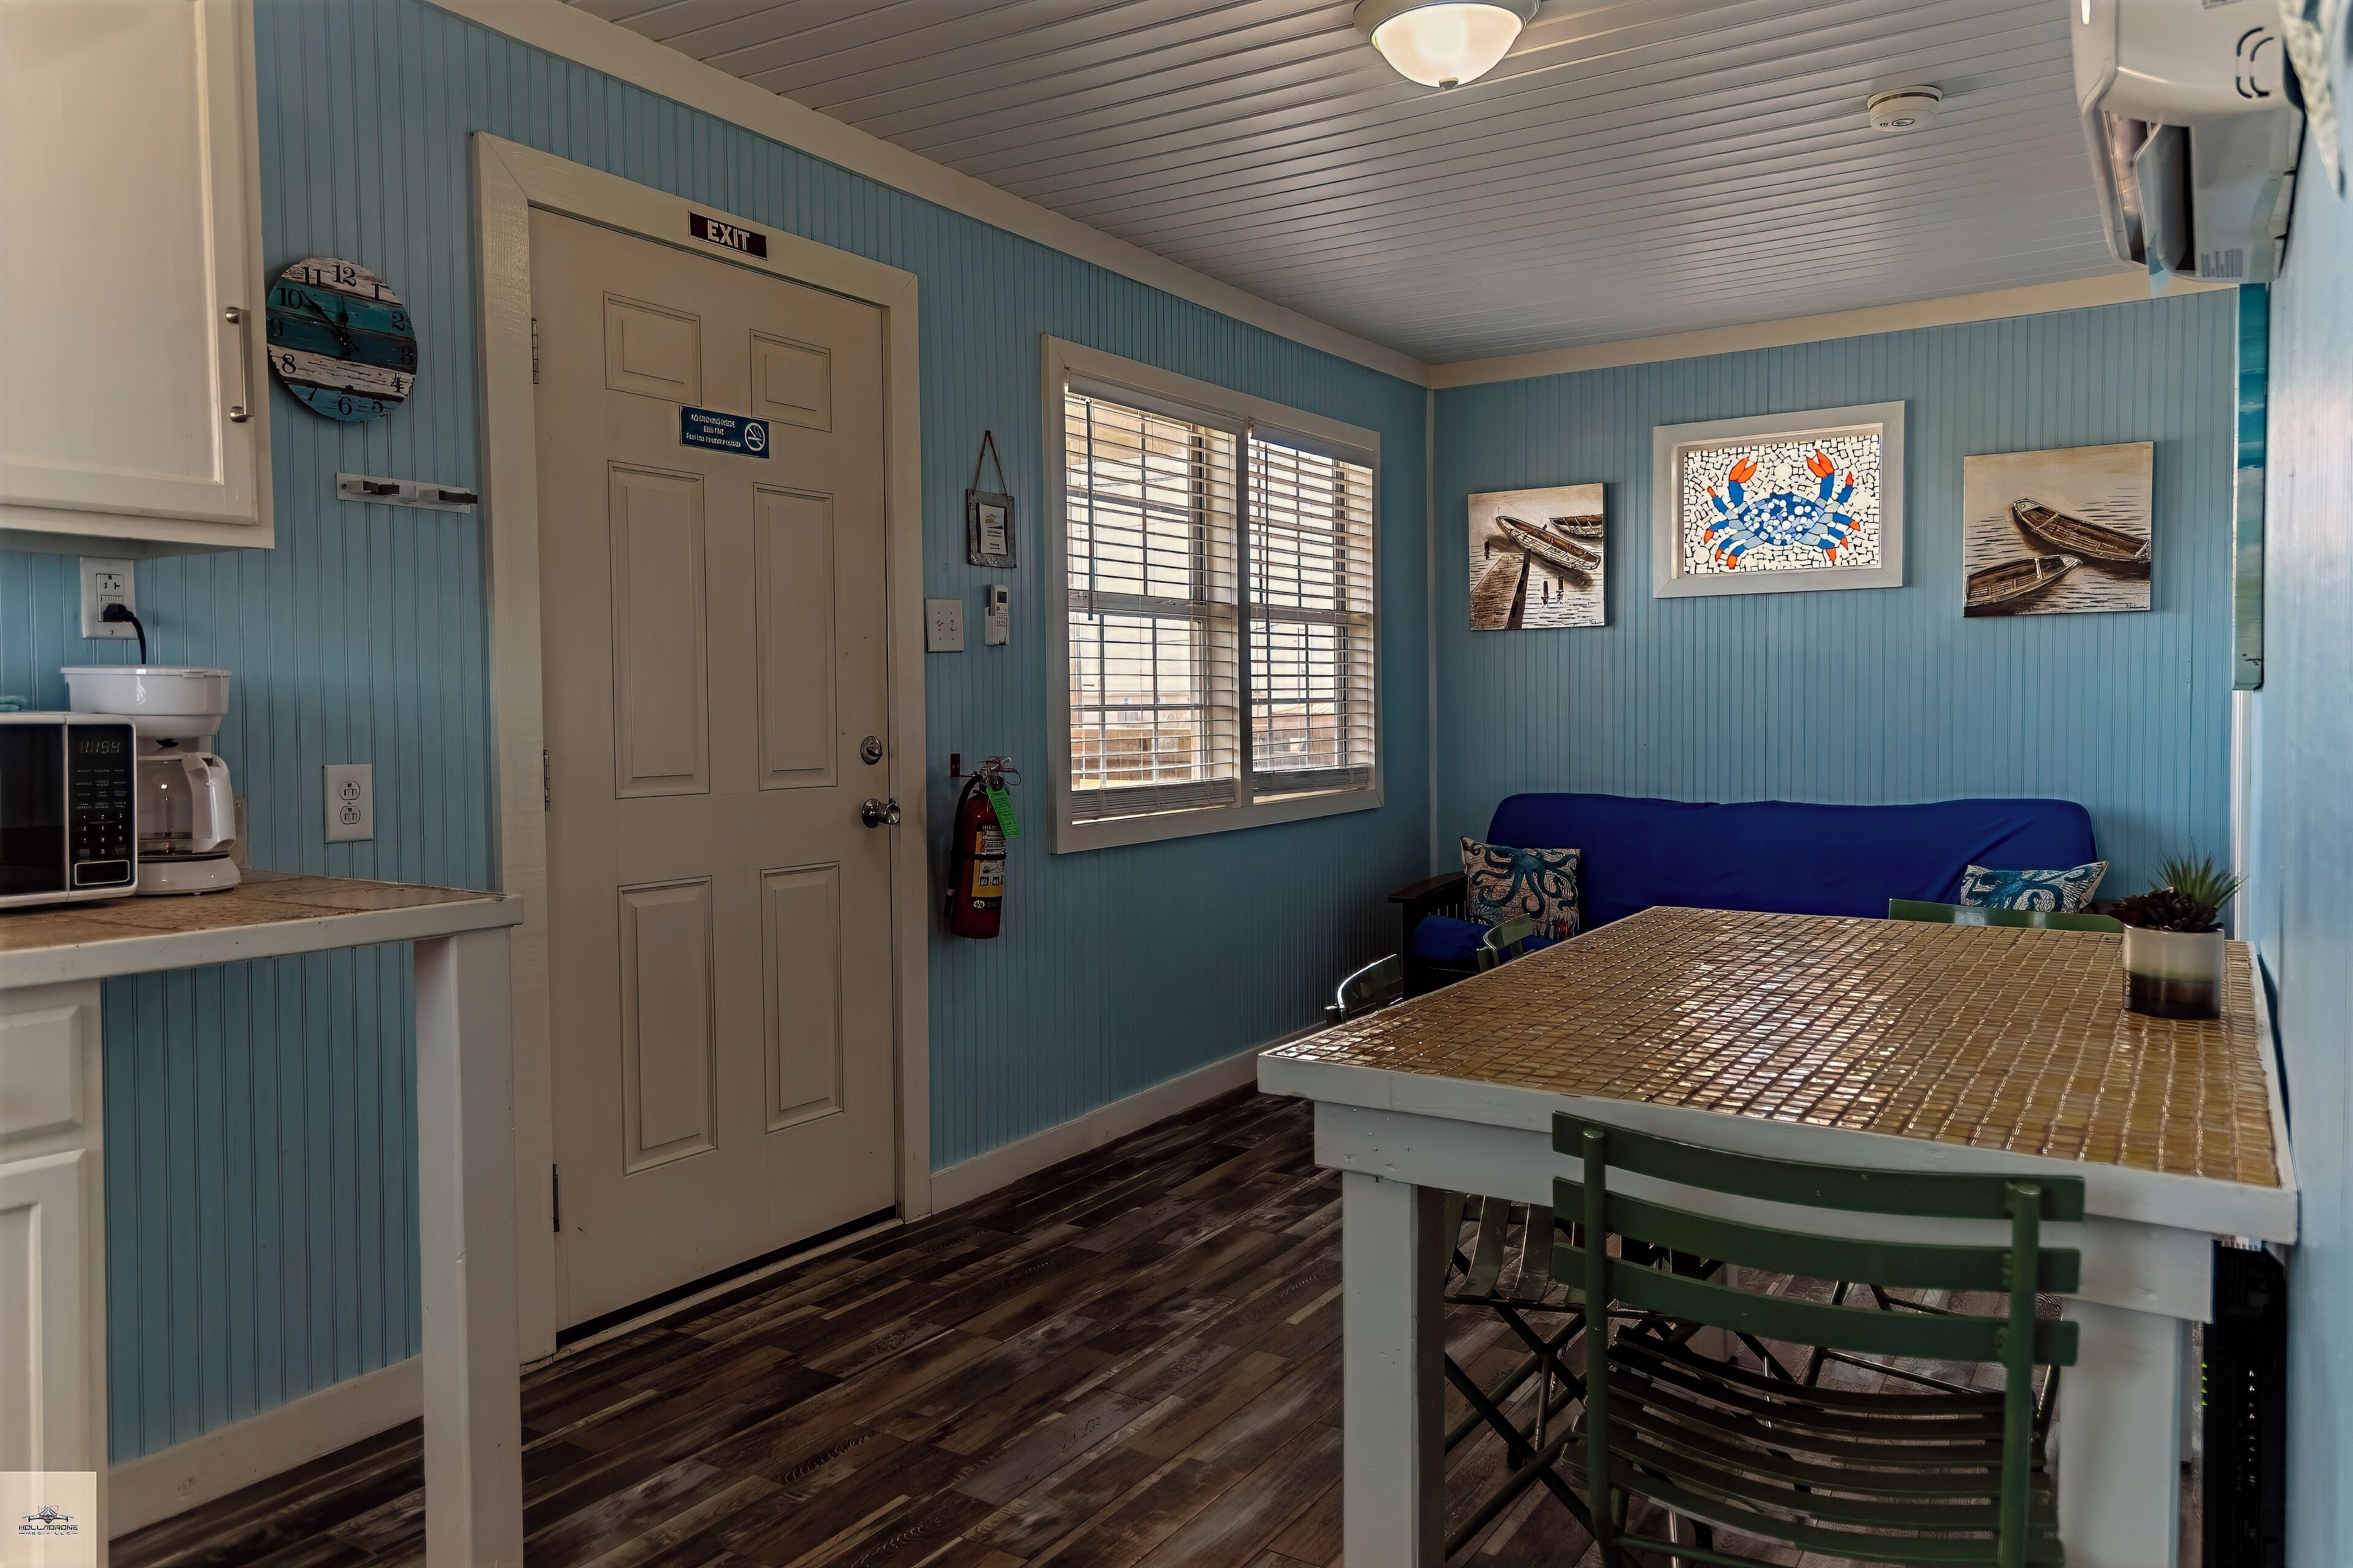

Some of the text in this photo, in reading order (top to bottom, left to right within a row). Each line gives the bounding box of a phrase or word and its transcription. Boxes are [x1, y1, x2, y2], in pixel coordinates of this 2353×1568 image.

[707, 219, 750, 251] EXIT
[304, 266, 322, 286] 11
[333, 264, 357, 287] 12
[277, 287, 304, 309] 10
[372, 282, 381, 300] 1
[392, 311, 405, 331] 2
[281, 353, 297, 374] 8
[307, 385, 319, 401] 7
[390, 372, 404, 394] 4
[338, 396, 353, 415] 6
